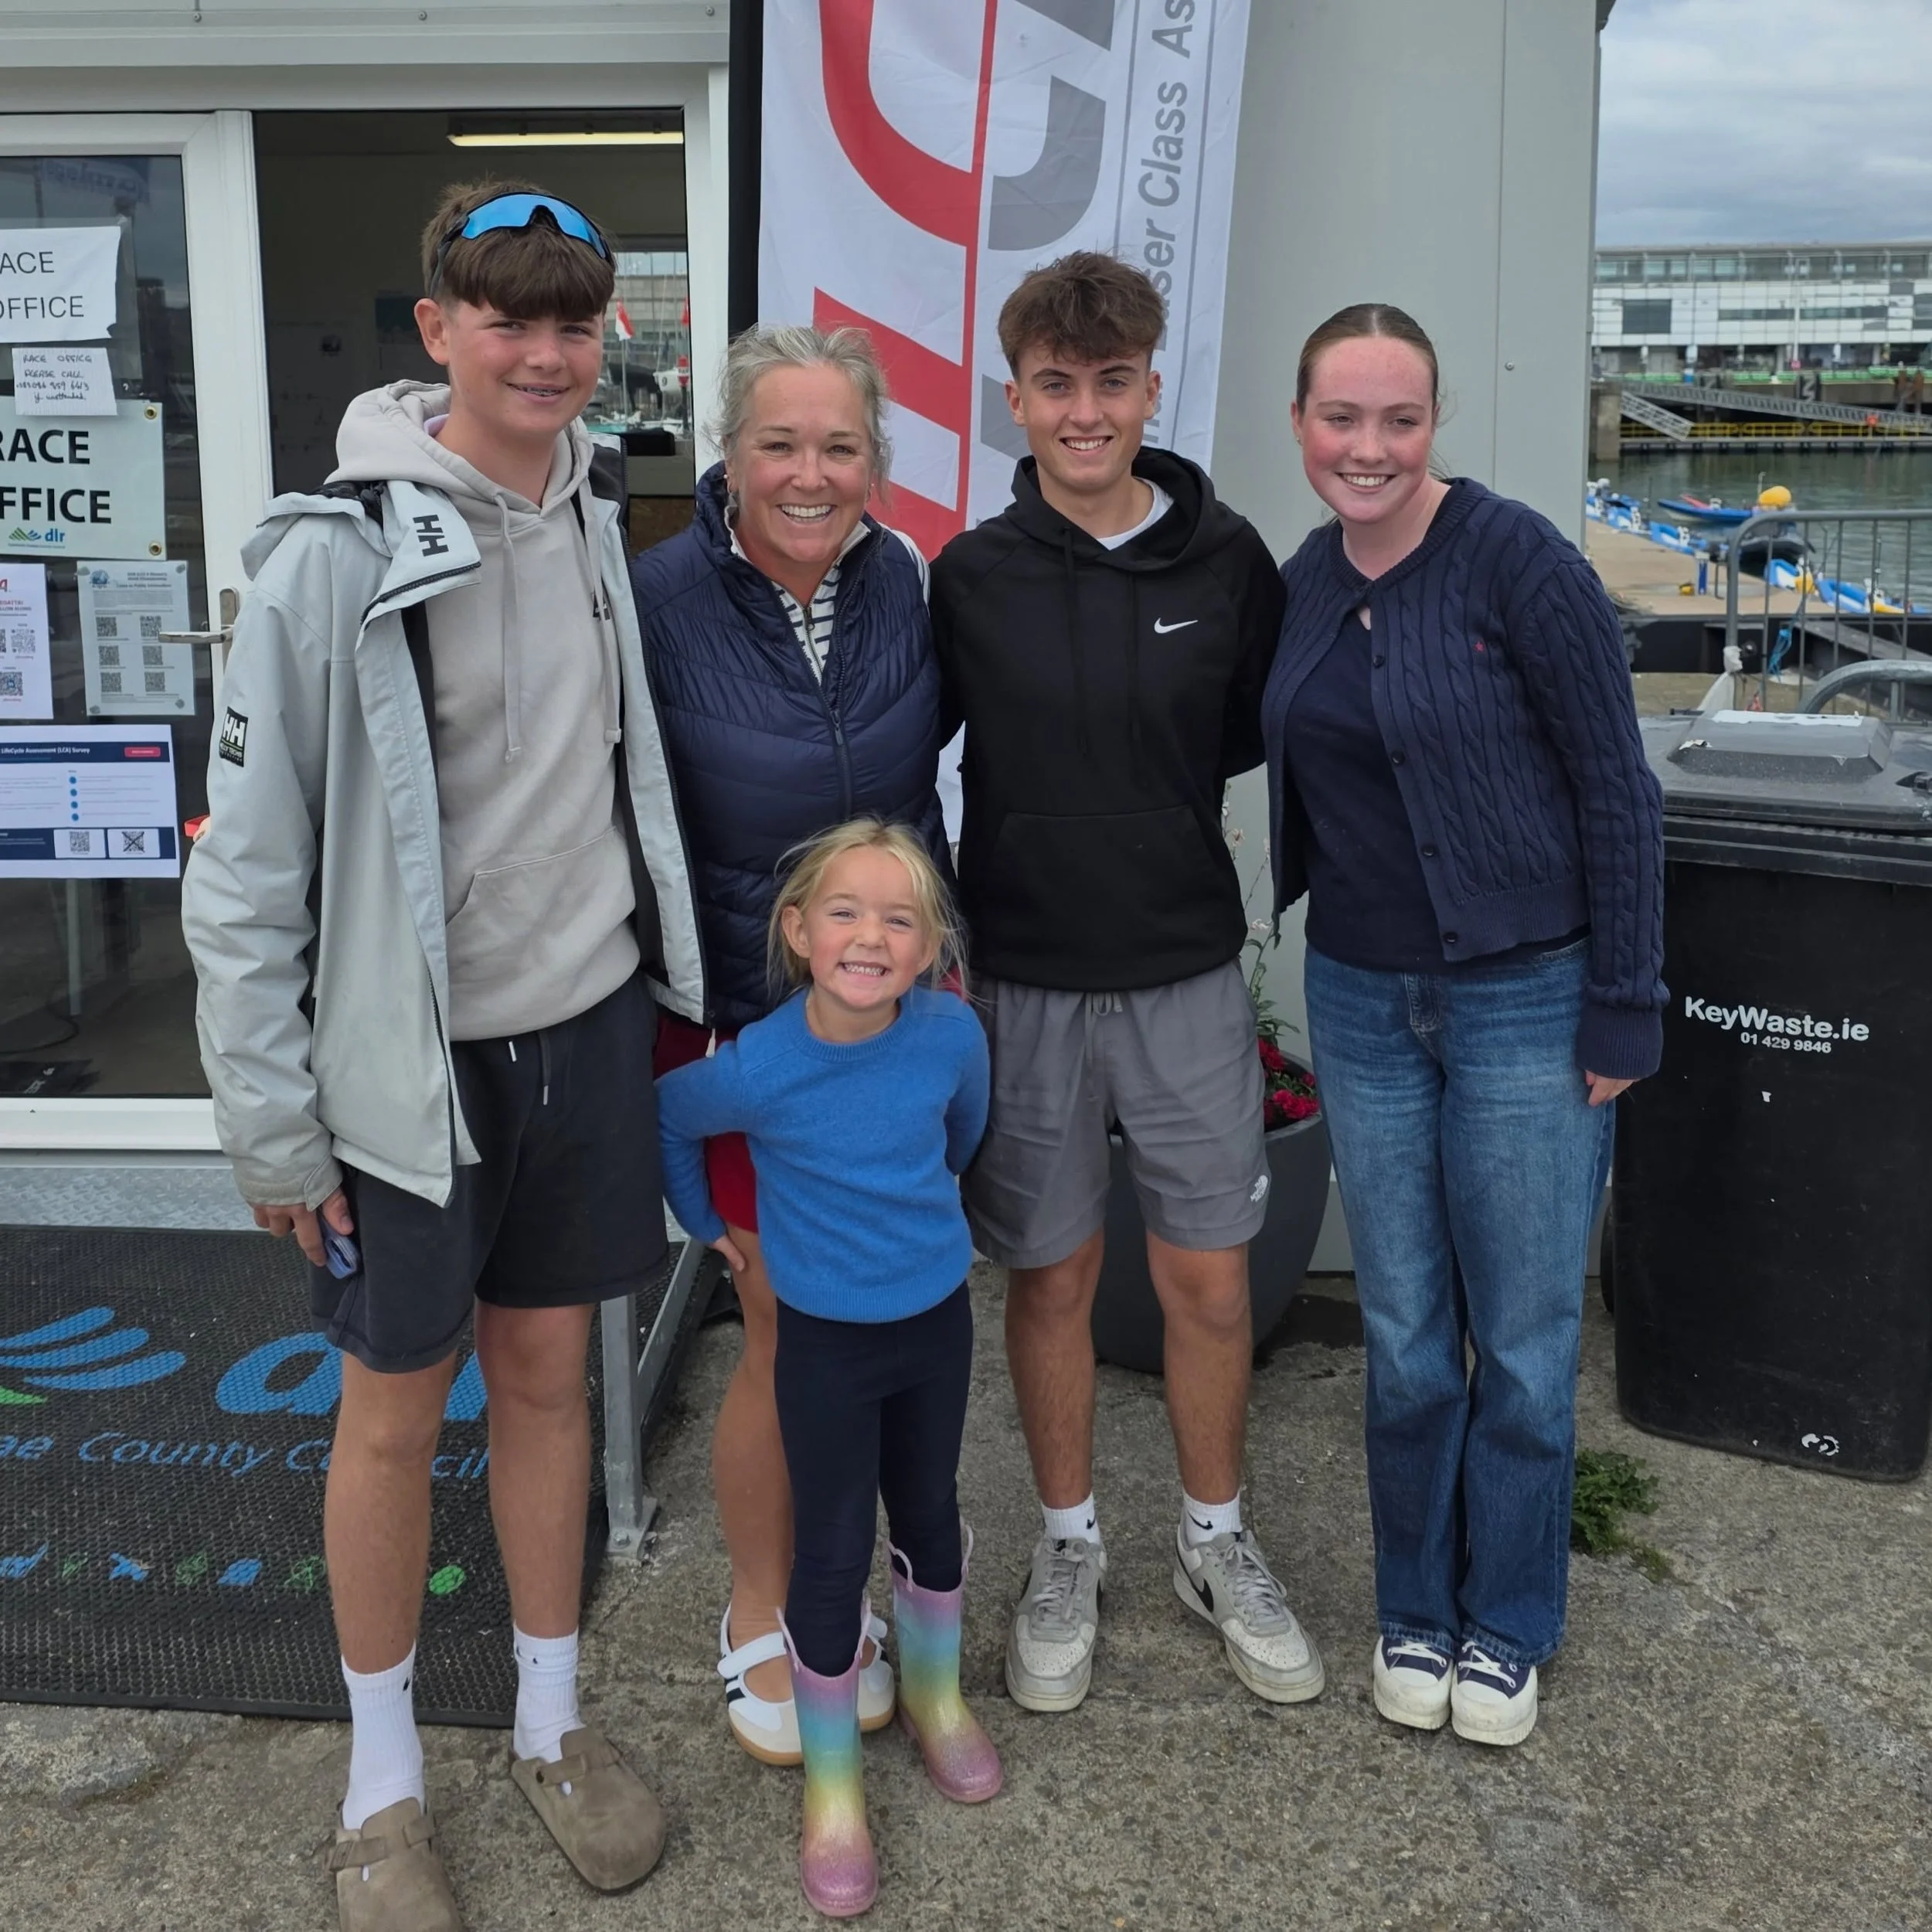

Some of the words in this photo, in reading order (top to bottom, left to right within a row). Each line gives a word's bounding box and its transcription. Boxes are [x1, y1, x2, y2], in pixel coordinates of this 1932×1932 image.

[1138, 81, 1188, 207] Class
[0, 295, 84, 319] FFICE
[44, 529, 66, 543] dlr
[413, 514, 449, 556] HH
[223, 713, 246, 747] HH
[72, 747, 90, 755] Survey
[1685, 996, 1870, 1042] KeyWaste.ie
[1740, 1032, 1757, 1045] 01
[1761, 1036, 1791, 1049] 429
[1794, 1040, 1832, 1054] 9846
[78, 1431, 270, 1477] County
